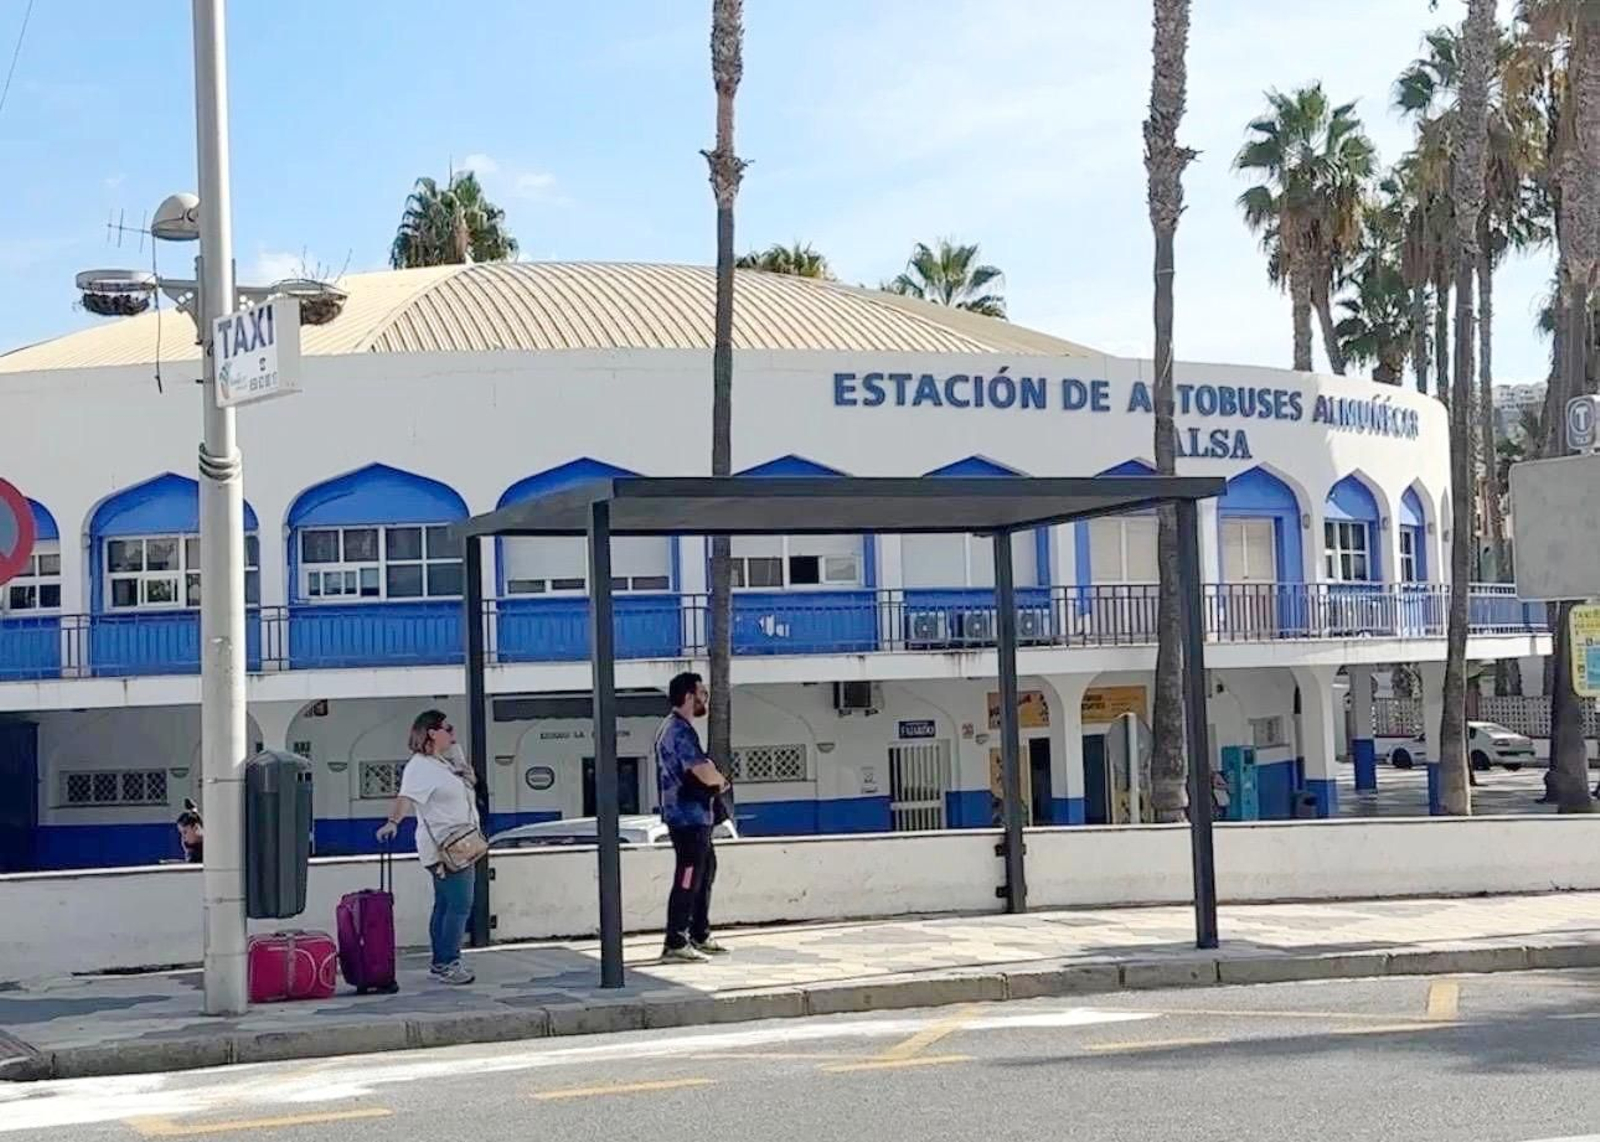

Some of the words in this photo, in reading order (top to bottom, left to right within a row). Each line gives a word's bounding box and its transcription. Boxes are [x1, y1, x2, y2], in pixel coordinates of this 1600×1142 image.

[218, 304, 274, 359] TAXI
[833, 366, 1047, 410] ESTACIÓN
[1062, 378, 1111, 412] DE
[1127, 381, 1304, 422] ATOBUSES
